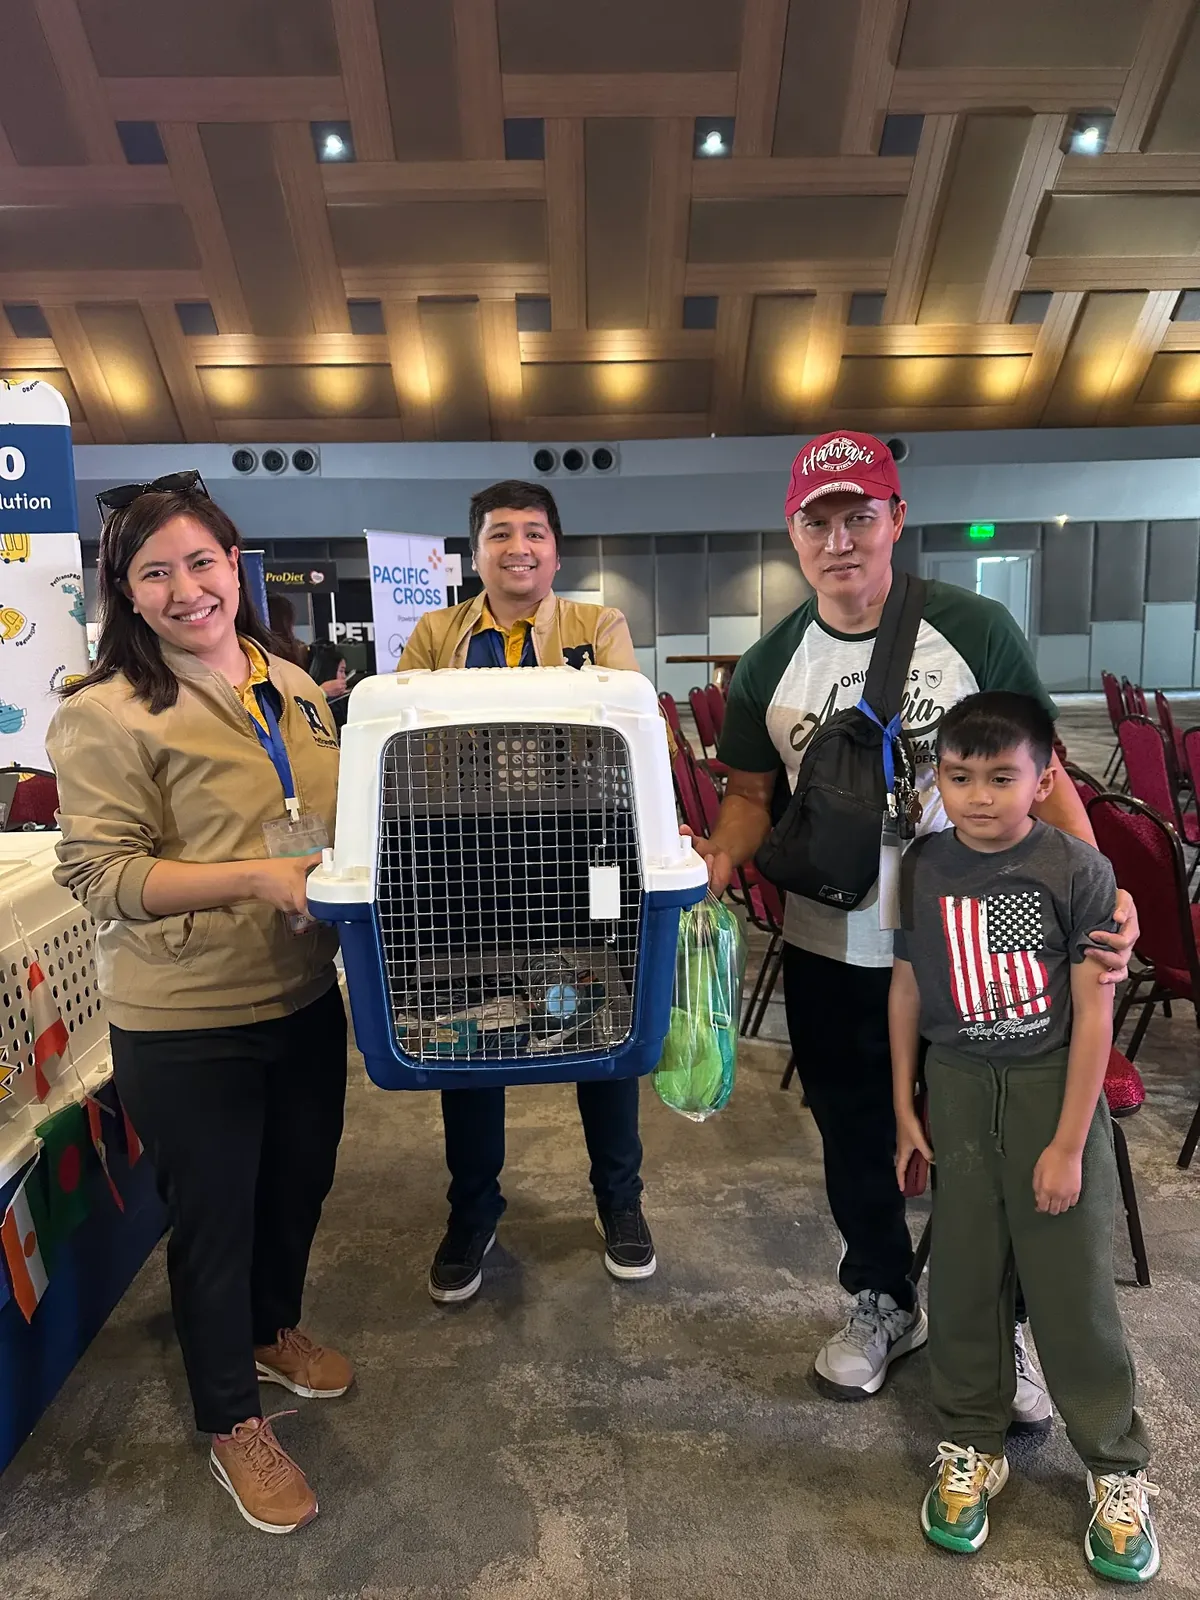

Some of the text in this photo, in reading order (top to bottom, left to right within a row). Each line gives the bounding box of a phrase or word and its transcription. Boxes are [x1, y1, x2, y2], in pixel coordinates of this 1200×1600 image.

[801, 442, 875, 476] Hawaii
[265, 572, 304, 582] ProDiet
[372, 565, 430, 586] PACIFIC
[393, 587, 442, 606] CROSS
[328, 622, 374, 642] PET
